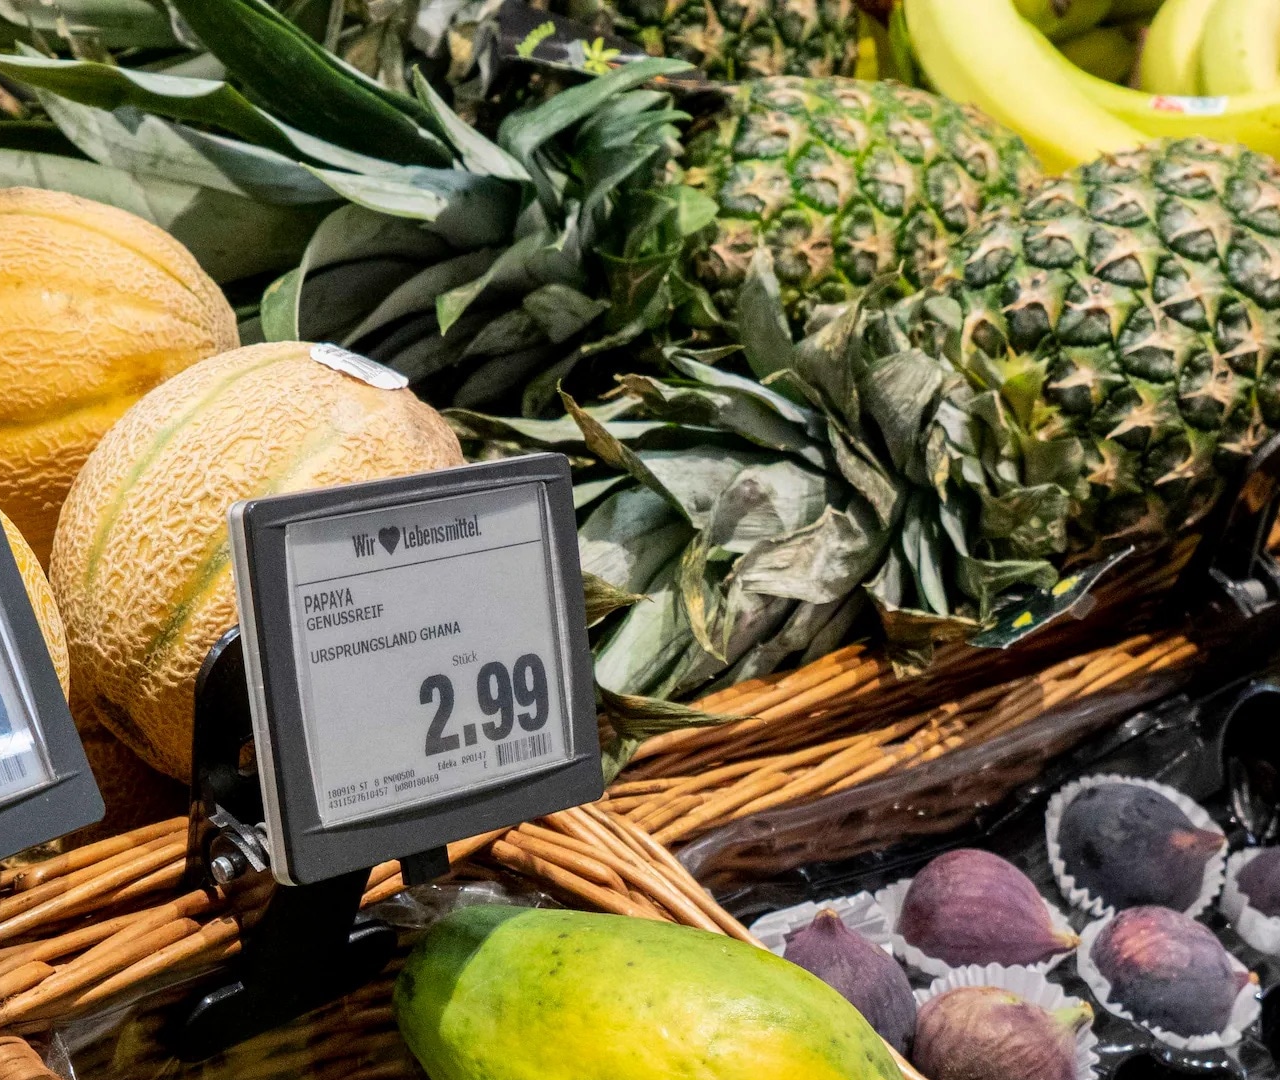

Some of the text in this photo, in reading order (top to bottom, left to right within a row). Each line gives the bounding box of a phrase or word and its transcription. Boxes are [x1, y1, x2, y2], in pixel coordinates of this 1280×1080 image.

[351, 513, 483, 560] Wir Lebensmittel.
[303, 586, 355, 614] PAPAYA
[305, 602, 385, 632] GENUSSREIF
[310, 620, 462, 665] URSPRUNGSLAND GHANA
[451, 650, 479, 668] Stück
[418, 652, 551, 757] 2.99
[437, 760, 458, 771] Edeka
[327, 784, 356, 800] 180919
[359, 780, 370, 792] ST
